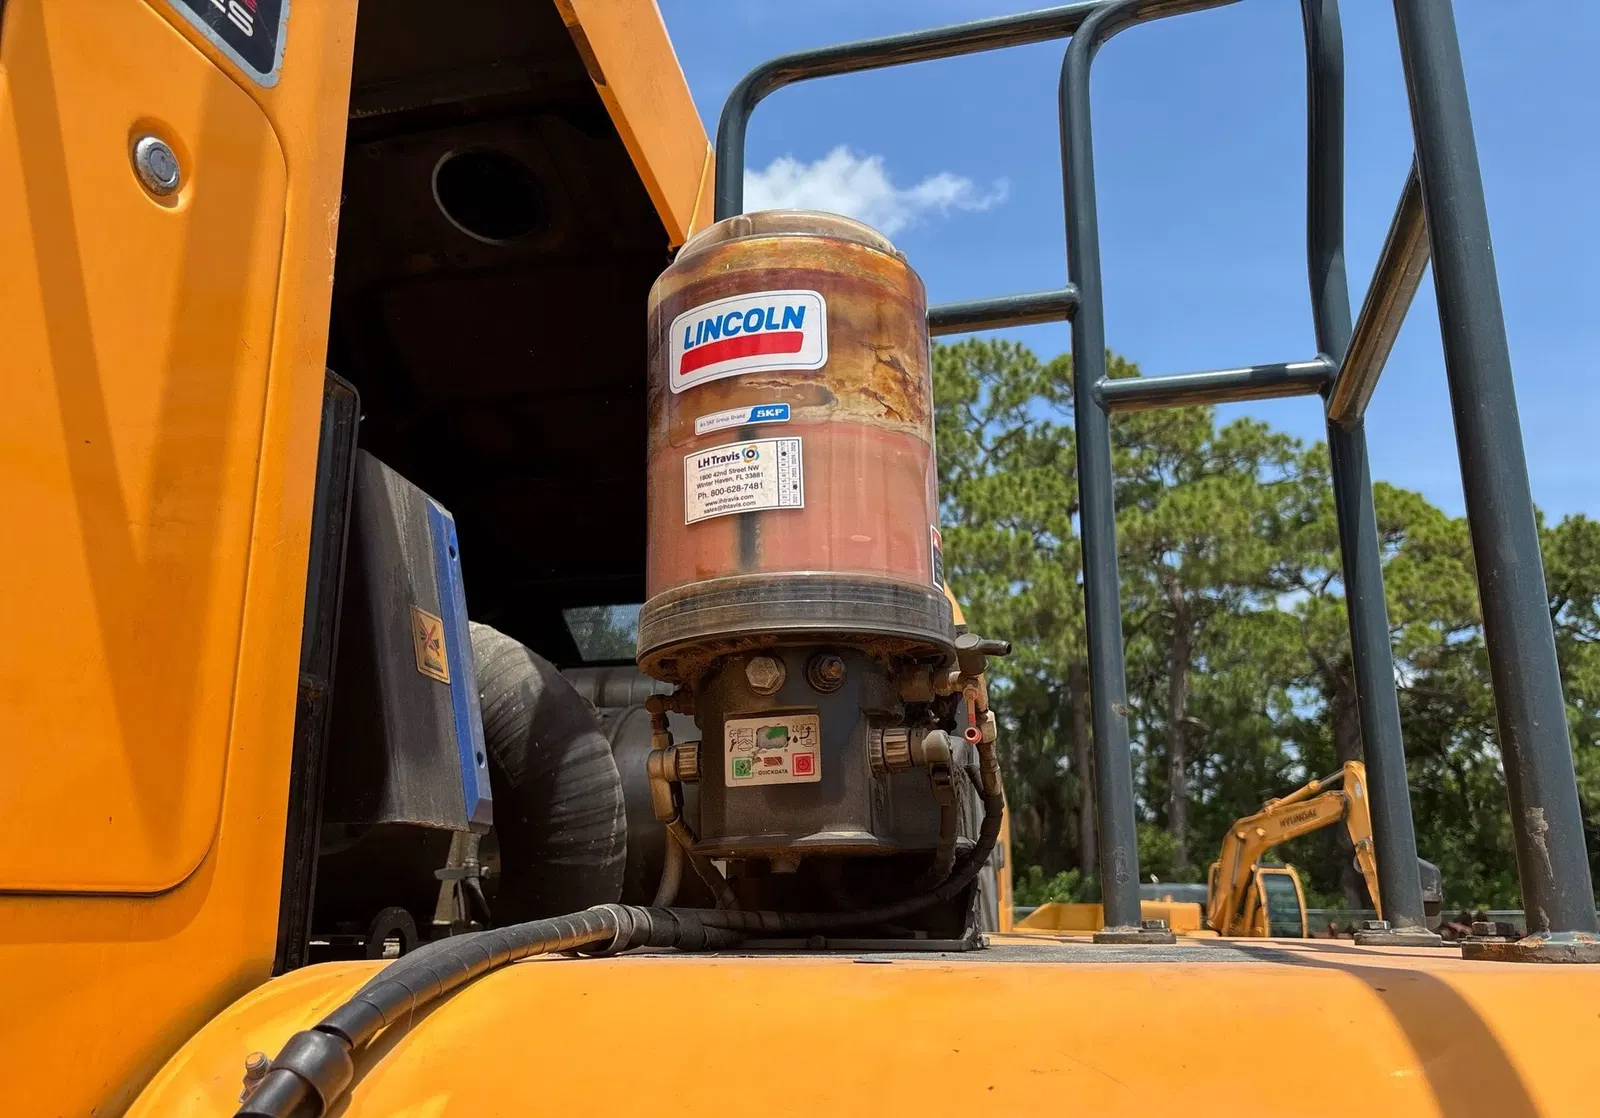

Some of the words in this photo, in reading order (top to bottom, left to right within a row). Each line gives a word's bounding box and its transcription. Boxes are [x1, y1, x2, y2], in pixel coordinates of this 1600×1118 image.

[683, 305, 806, 350] LINCOLN
[756, 408, 784, 418] SKF
[698, 457, 710, 469] LH
[711, 451, 740, 465] Travis
[699, 473, 712, 481] 1800
[728, 467, 747, 475] Street
[696, 480, 713, 489] Winter
[714, 476, 734, 485] Haven,
[697, 492, 709, 500] Ph.
[710, 482, 764, 496] 800-628-7481
[705, 494, 754, 507] www.lhtravis.com
[1280, 808, 1317, 828] HYUNDAI
